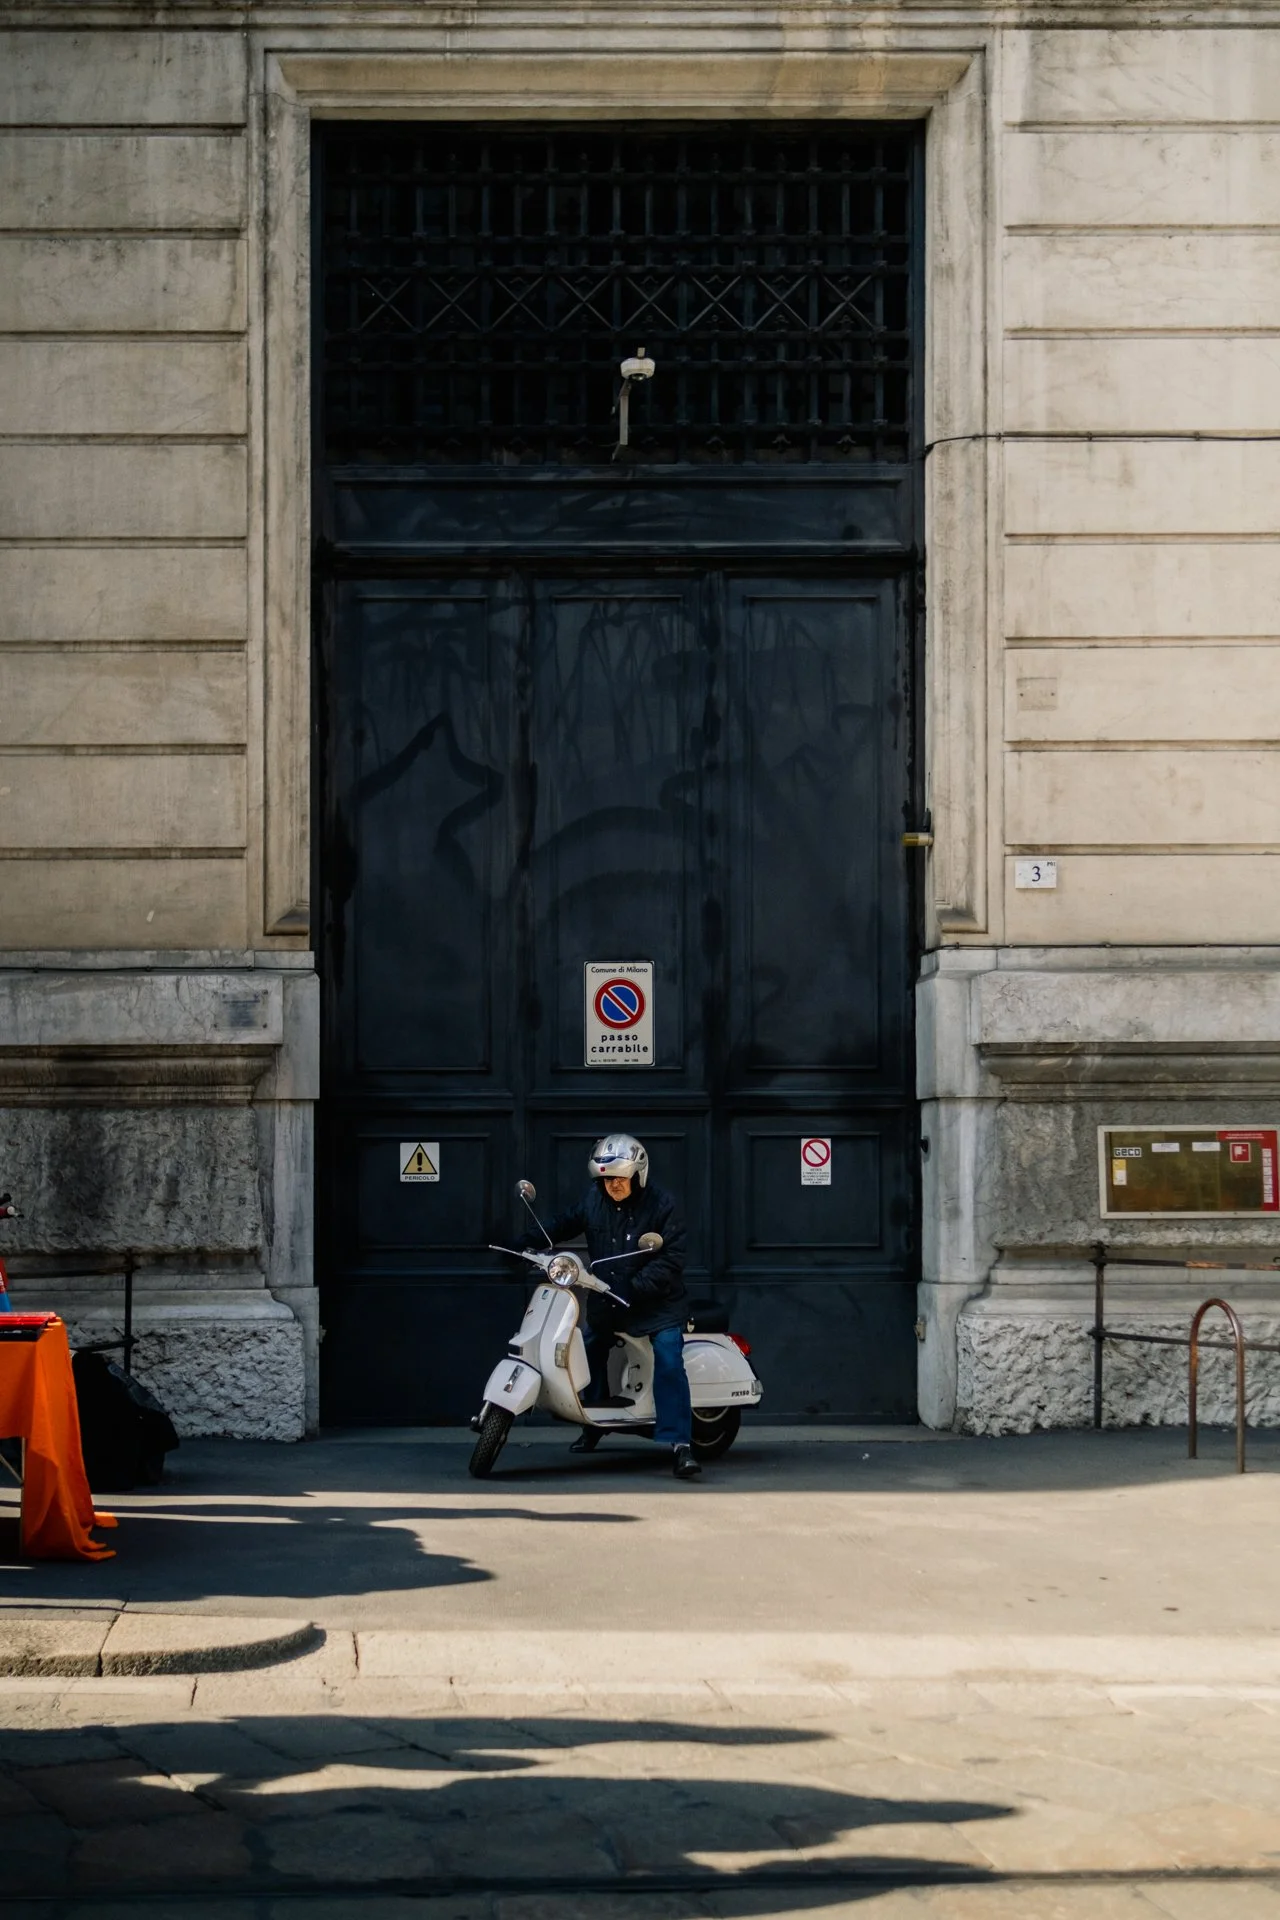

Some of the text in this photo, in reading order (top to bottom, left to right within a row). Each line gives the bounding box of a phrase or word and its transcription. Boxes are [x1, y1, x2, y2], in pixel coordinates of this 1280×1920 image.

[1031, 865, 1041, 882] 3
[601, 1034, 638, 1043] passo
[591, 1044, 649, 1053] carrabile
